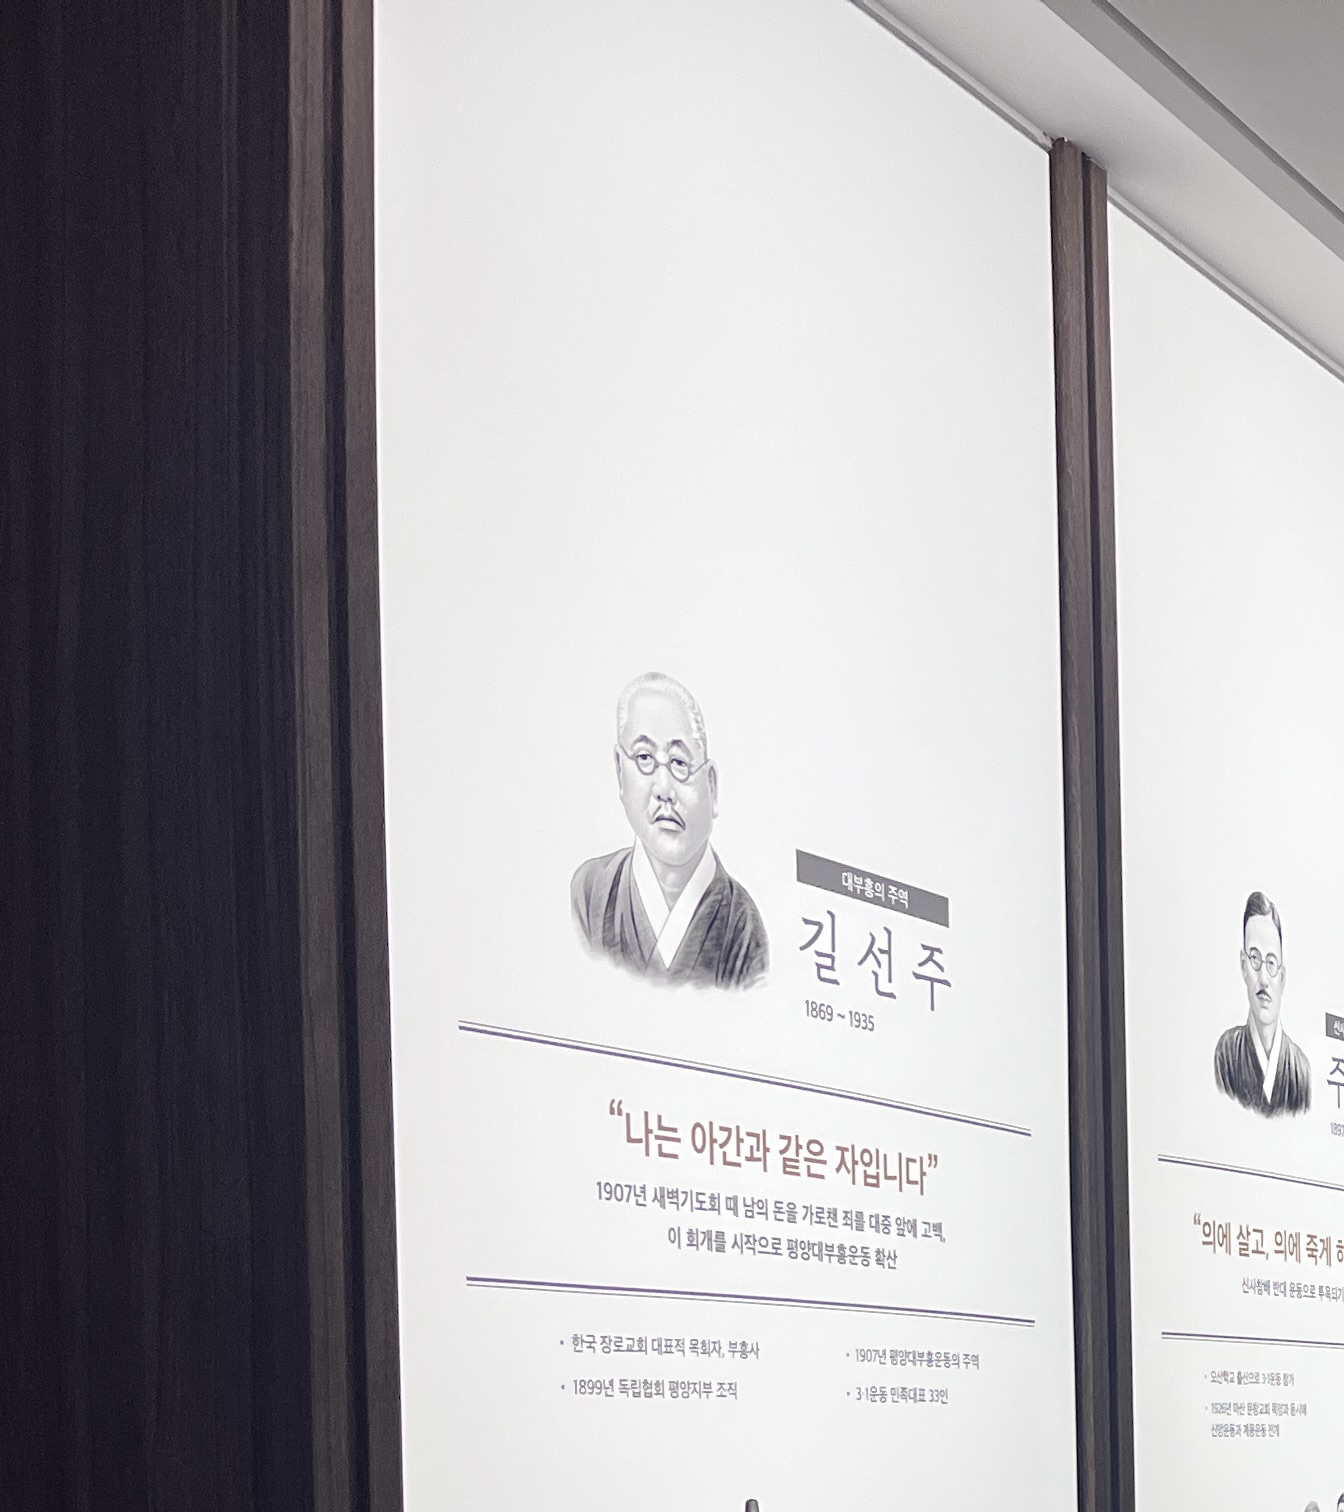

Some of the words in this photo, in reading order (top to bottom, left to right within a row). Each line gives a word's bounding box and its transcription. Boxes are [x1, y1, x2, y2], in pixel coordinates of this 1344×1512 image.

[842, 872, 885, 902] 대부흥의
[888, 884, 909, 909] 주역
[805, 1000, 834, 1022] 1869
[849, 1010, 875, 1031] 1935
[609, 1098, 682, 1160] “나는
[691, 1121, 770, 1173] 아간과
[778, 1133, 828, 1180] 같은
[835, 1144, 939, 1196] 자입니다”
[596, 1181, 647, 1207] 1907년
[651, 1186, 721, 1216] 새벽기도회
[725, 1194, 739, 1217] 때
[743, 1196, 769, 1221] 남의
[773, 1202, 798, 1223] 돈을
[802, 1203, 839, 1229] 가로챈
[842, 1210, 866, 1232] 죄를
[869, 1213, 892, 1235] 대중
[895, 1216, 918, 1238] 앞에
[921, 1221, 946, 1243] 고백,
[668, 1225, 682, 1250] 이
[686, 1227, 727, 1253] 회개를
[731, 1232, 783, 1257] 시작으로
[786, 1238, 871, 1266] 평양대부흥운동
[874, 1248, 898, 1270] 확산
[1193, 1213, 1232, 1256] “의에
[1236, 1224, 1269, 1261] 살고,
[1274, 1229, 1301, 1264] 의에
[1305, 1234, 1332, 1268] 죽게
[1273, 1280, 1287, 1298] 반대
[1289, 1281, 1317, 1299] 운동으로
[572, 1333, 598, 1354] 한국
[600, 1334, 649, 1355] 장로교회
[651, 1336, 686, 1357] 대표적
[689, 1338, 725, 1359] 목회자,
[728, 1339, 760, 1360] 부흥사
[855, 1347, 888, 1365] 1907년
[889, 1349, 961, 1369] 평양대부흥운동의
[962, 1352, 980, 1370] 주역
[572, 1378, 615, 1398] 1899년
[618, 1378, 666, 1399] 독립협회
[668, 1379, 714, 1400] 평양지부
[716, 1380, 738, 1400] 조직
[889, 1387, 926, 1404] 민족대표
[928, 1388, 949, 1405] 33인
